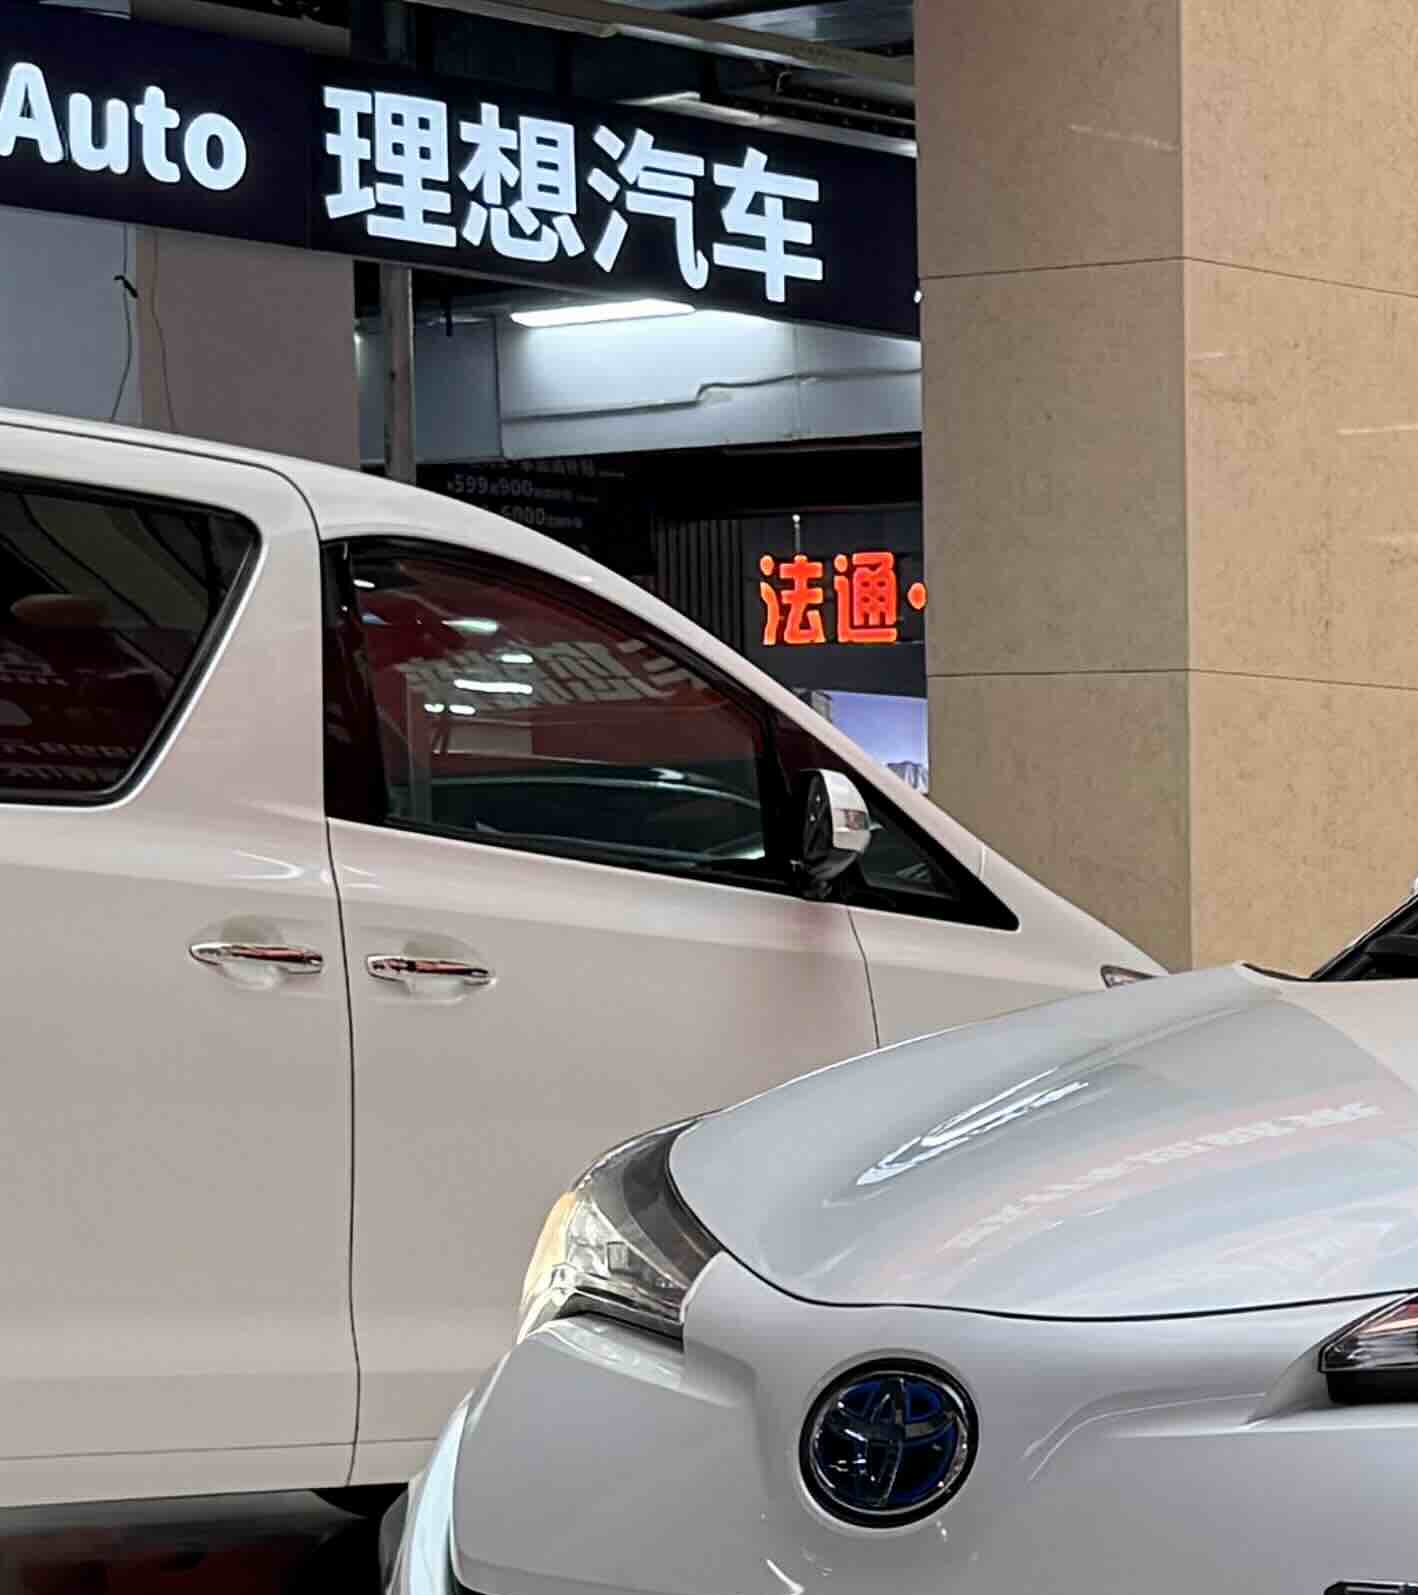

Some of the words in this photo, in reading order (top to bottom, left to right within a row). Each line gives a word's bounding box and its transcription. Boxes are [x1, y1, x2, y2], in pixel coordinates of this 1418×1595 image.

[0, 63, 247, 192] Auto
[323, 85, 825, 303] 理想汽车
